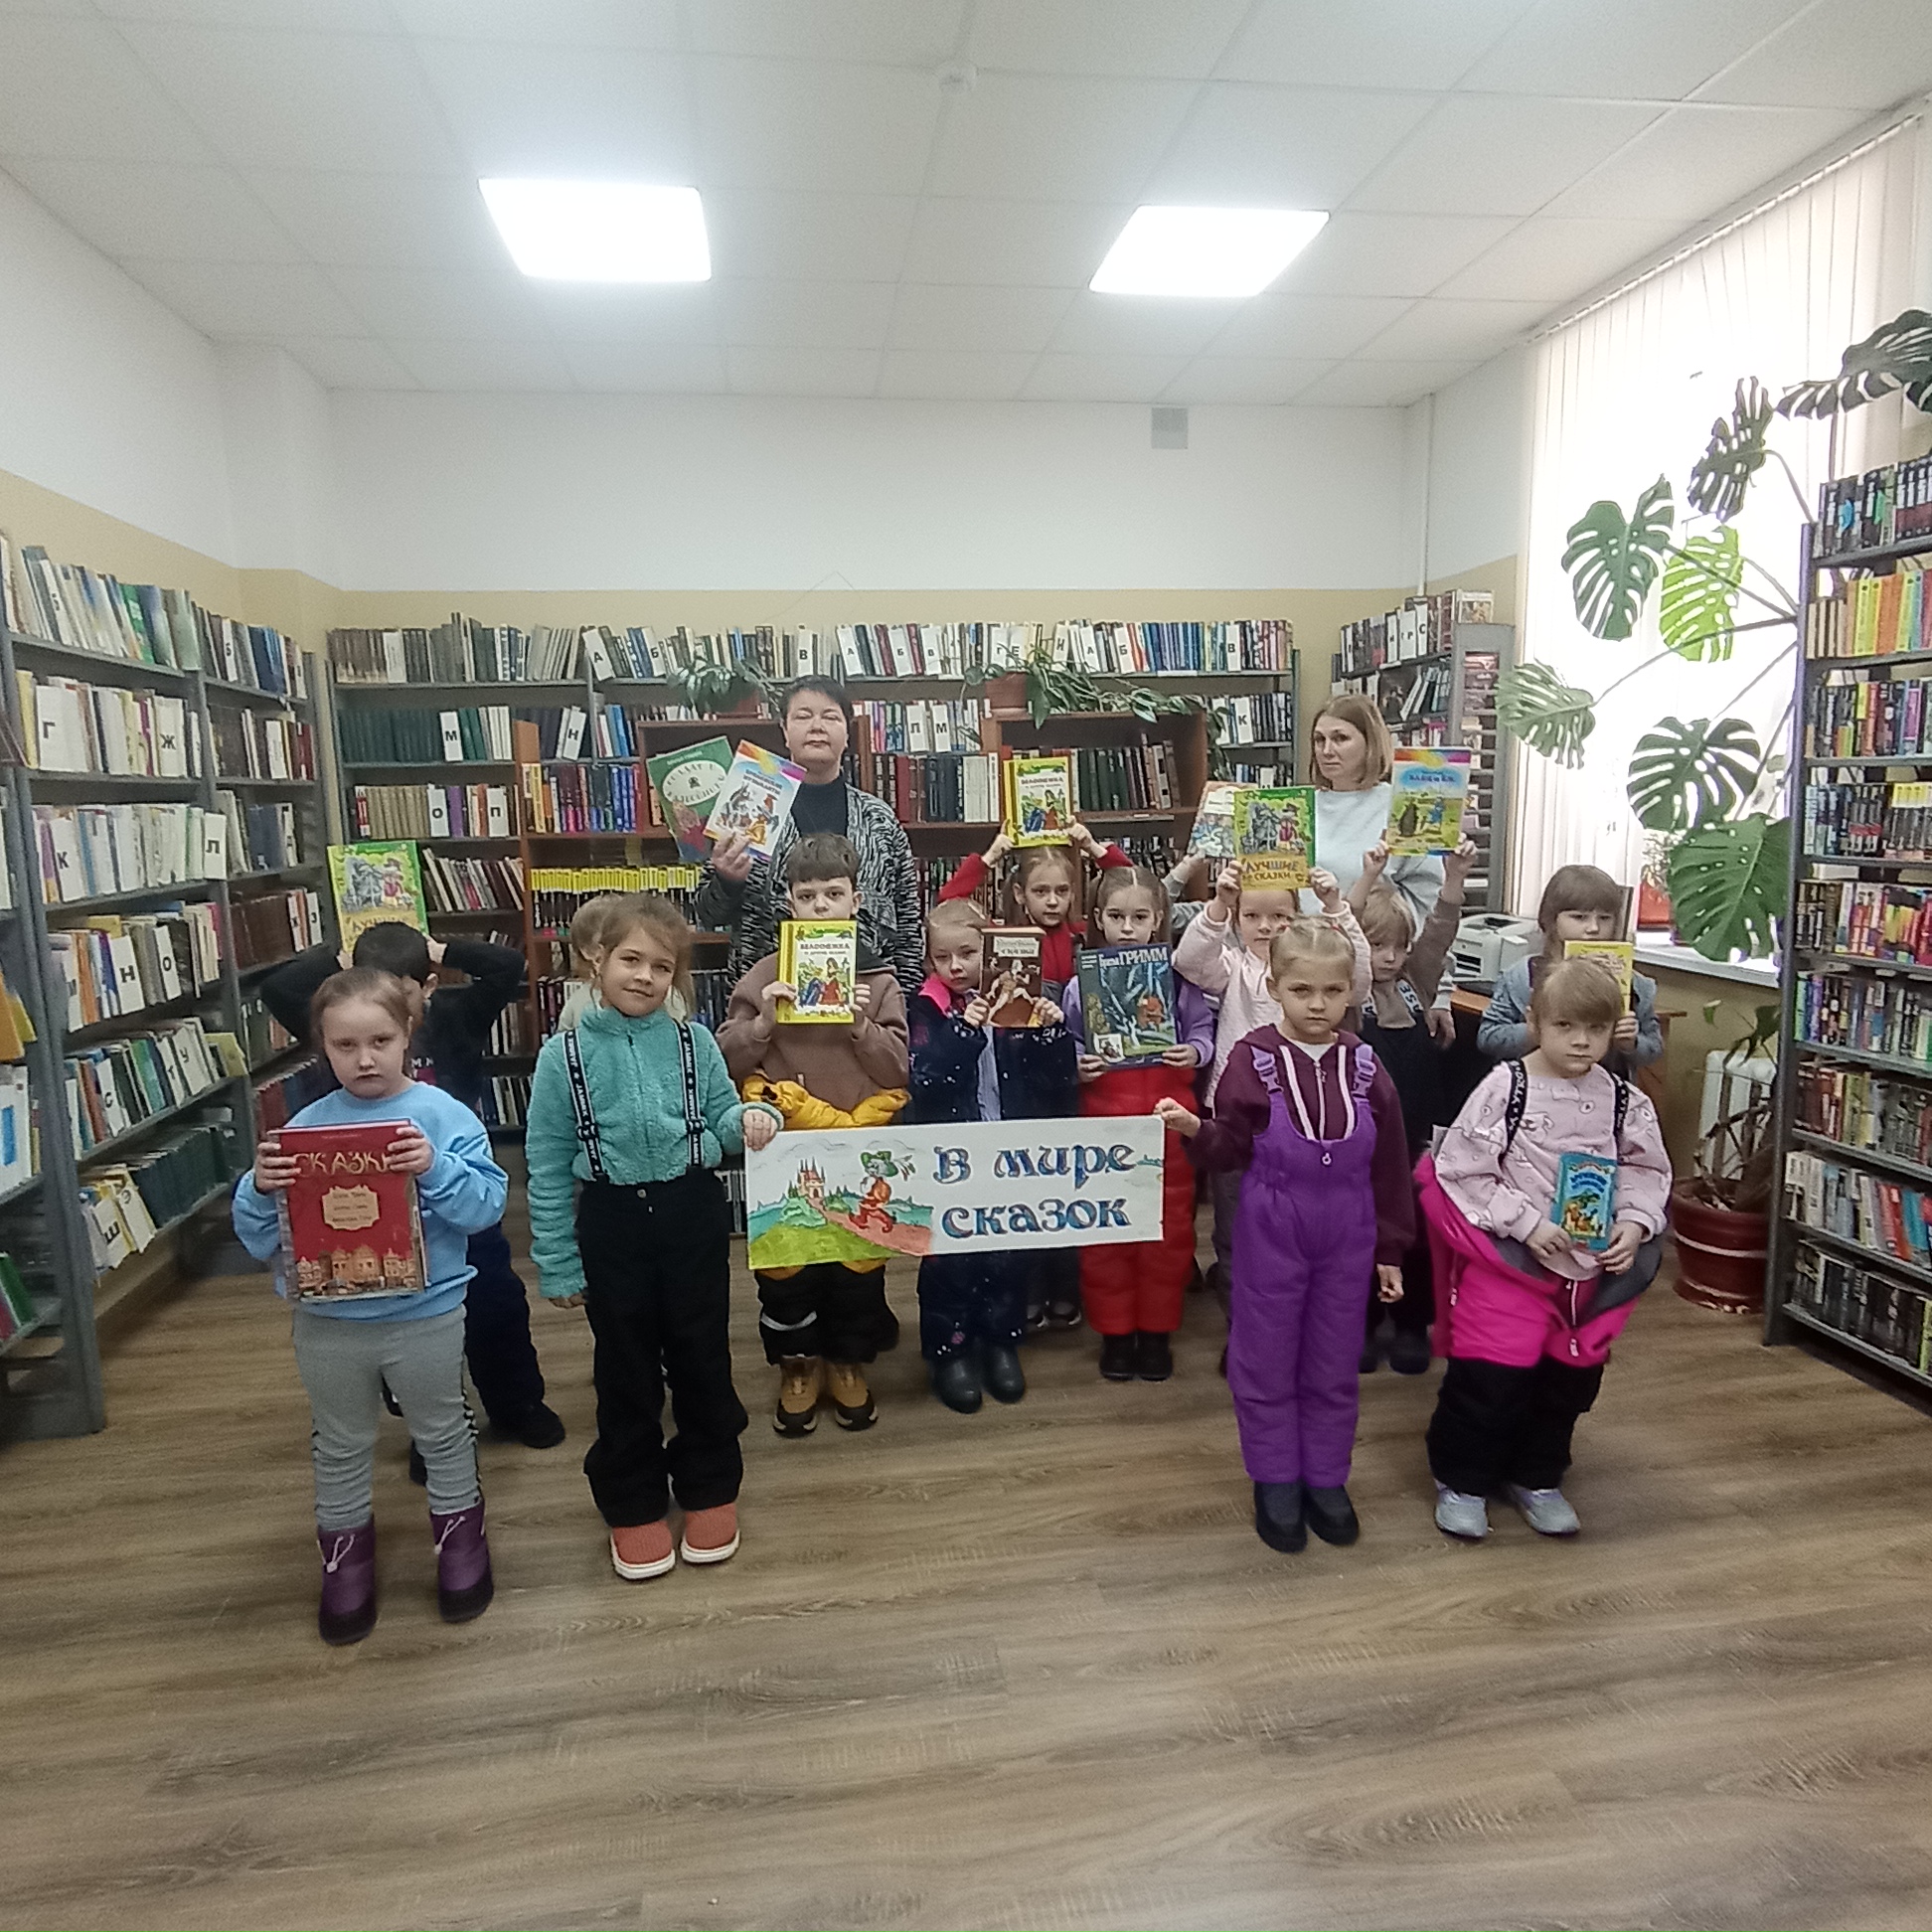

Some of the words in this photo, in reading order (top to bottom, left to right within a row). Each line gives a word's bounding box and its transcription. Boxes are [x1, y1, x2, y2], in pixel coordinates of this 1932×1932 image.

[651, 647, 659, 658] Б
[1119, 645, 1127, 655] Б
[1227, 643, 1235, 653] В
[594, 652, 603, 663] А
[799, 649, 808, 660] В
[1238, 715, 1247, 725] К
[42, 722, 55, 738] Г
[568, 728, 578, 740] Н
[910, 724, 920, 733] Л
[936, 724, 947, 733] М
[160, 733, 176, 750] Ж
[445, 730, 457, 741] М
[490, 807, 500, 817] П
[206, 840, 220, 854] Л
[57, 851, 69, 869] К
[1245, 861, 1298, 873] ЛУЧШИЕ
[1254, 872, 1291, 881] СКАЗКИ
[1118, 947, 1168, 965] ГРИММ
[119, 965, 135, 983] Н
[179, 1047, 189, 1063] У
[104, 1092, 113, 1108] С
[933, 1146, 971, 1185] В
[994, 1144, 1137, 1191] мире
[941, 1198, 1132, 1239] сказок
[103, 1221, 120, 1245] Ш
